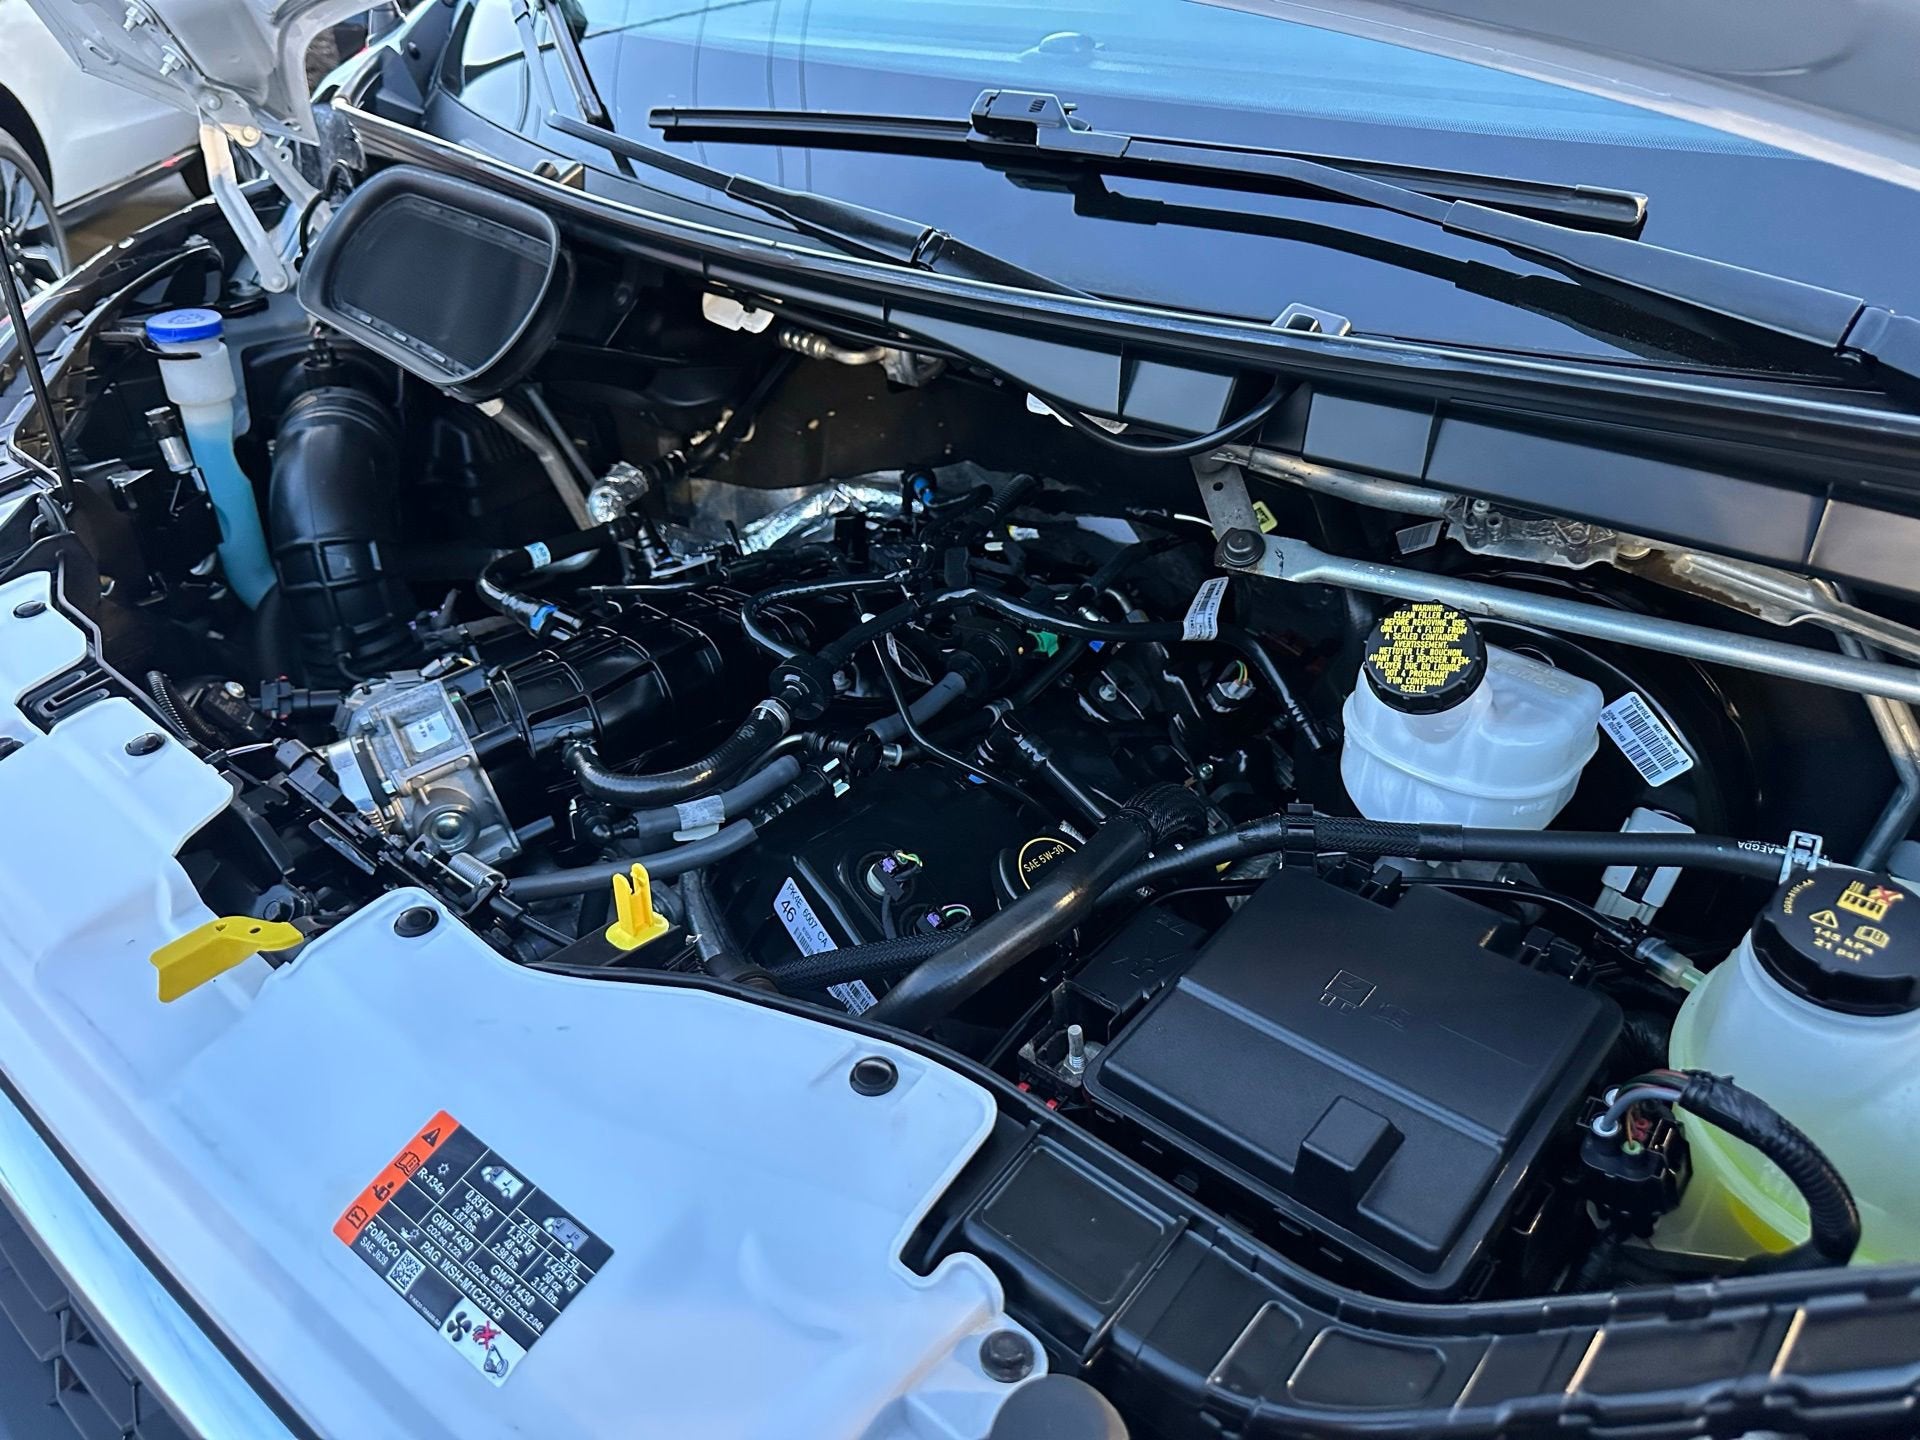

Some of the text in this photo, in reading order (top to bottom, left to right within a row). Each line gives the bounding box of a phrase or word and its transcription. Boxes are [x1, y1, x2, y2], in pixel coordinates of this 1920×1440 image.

[1379, 647, 1412, 655] NETTOYER
[1406, 677, 1445, 686] CONTENANT
[1409, 670, 1448, 679] PROVENANT
[1024, 845, 1064, 872] SAE 5W-30
[781, 900, 797, 923] 46
[803, 908, 818, 929] 6007
[817, 931, 828, 948] CA
[1813, 926, 1873, 955] 145 kPa
[1813, 938, 1861, 961] 21 psi
[417, 1167, 445, 1195] R-134a
[462, 1202, 481, 1222] 30 oz
[465, 1189, 493, 1219] 0.85 kg
[432, 1213, 474, 1252] GWP 1430
[452, 1208, 476, 1232] 1.87 lbs
[520, 1219, 539, 1239] 2.0L
[365, 1221, 400, 1257] FoMoCo
[426, 1224, 441, 1238] CO2
[438, 1236, 448, 1246] eq
[507, 1225, 536, 1256] 1.35 kg
[360, 1236, 388, 1266] SAE J639
[491, 1243, 518, 1269] 2.98 lbs
[512, 1247, 522, 1258] oz
[560, 1253, 579, 1273] 3.5L
[420, 1241, 441, 1262] PAG
[440, 1258, 504, 1319] WSH-M1C231-B
[467, 1261, 482, 1276] CO2
[480, 1273, 490, 1284] eq
[490, 1264, 535, 1306] GWP 1430
[542, 1272, 562, 1293] 50 oz
[544, 1255, 578, 1292] 1.425 kg
[531, 1277, 558, 1304] 3.14 lbs
[505, 1294, 544, 1331] CO2 eq 2.04t
